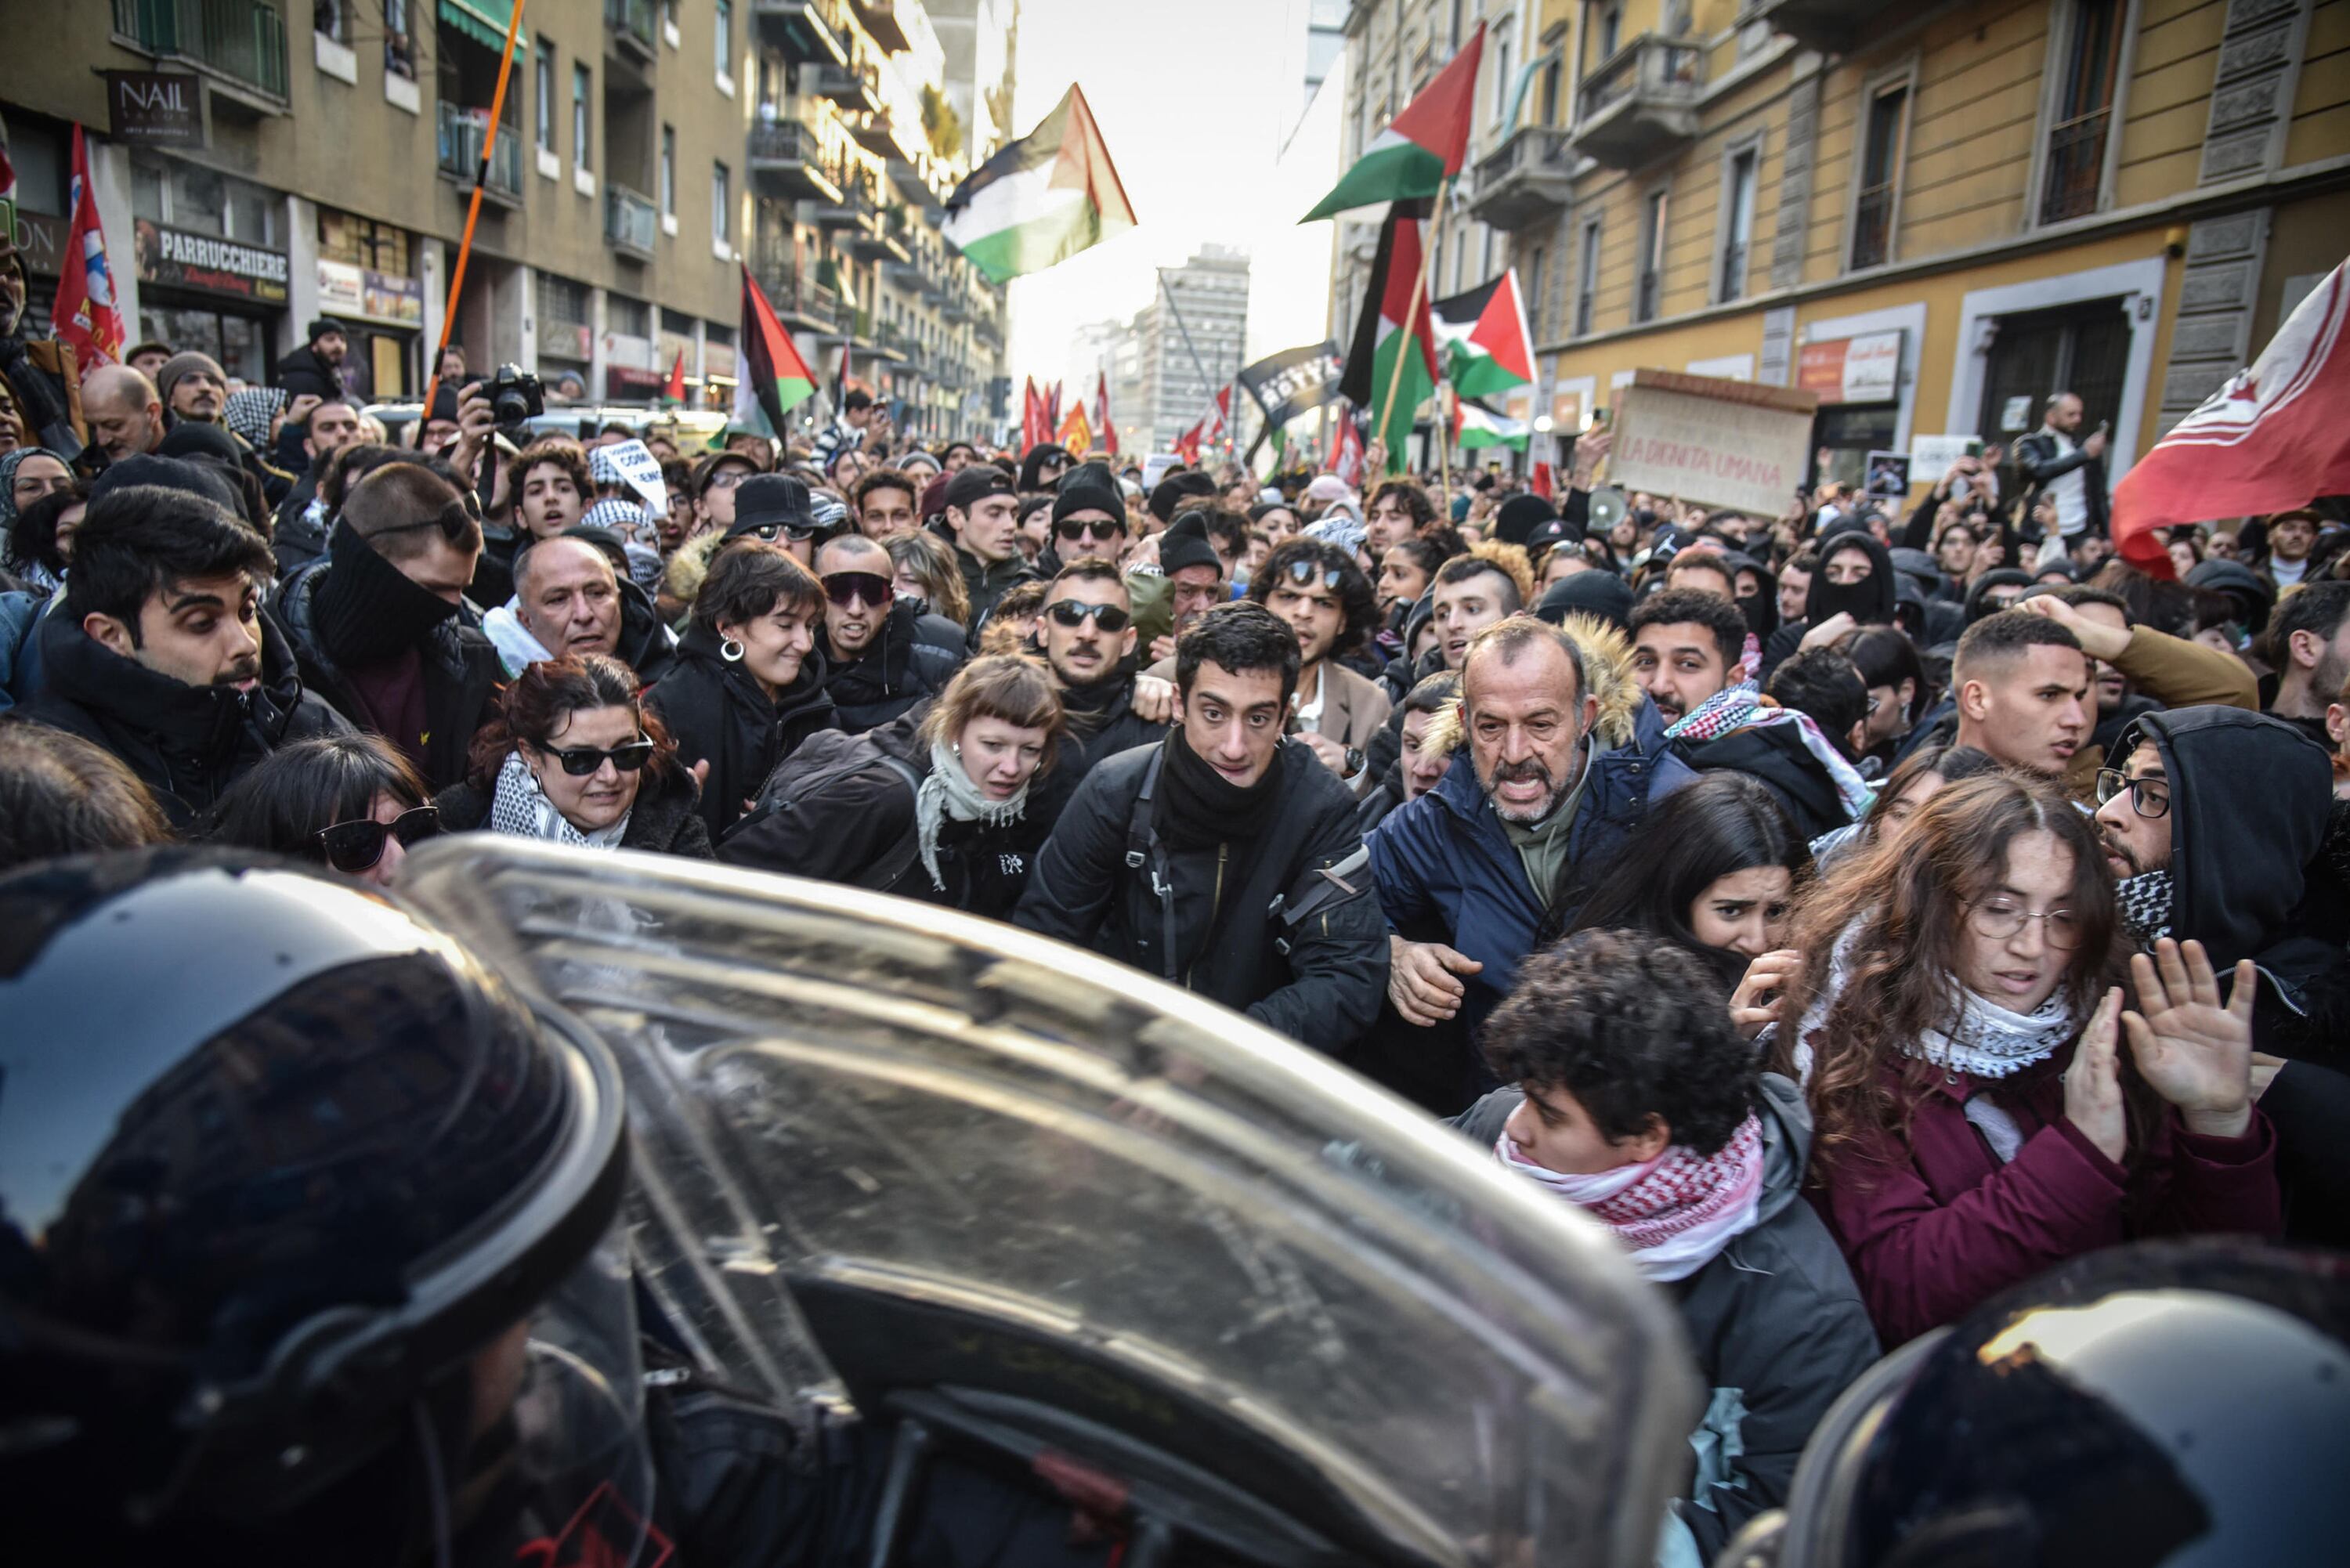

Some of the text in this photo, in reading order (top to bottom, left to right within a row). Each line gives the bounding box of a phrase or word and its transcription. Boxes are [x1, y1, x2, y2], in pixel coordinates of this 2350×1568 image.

[120, 80, 190, 111] NAIL
[160, 230, 287, 284] PARRUCCHIERE
[1715, 453, 1781, 489] UMANA
